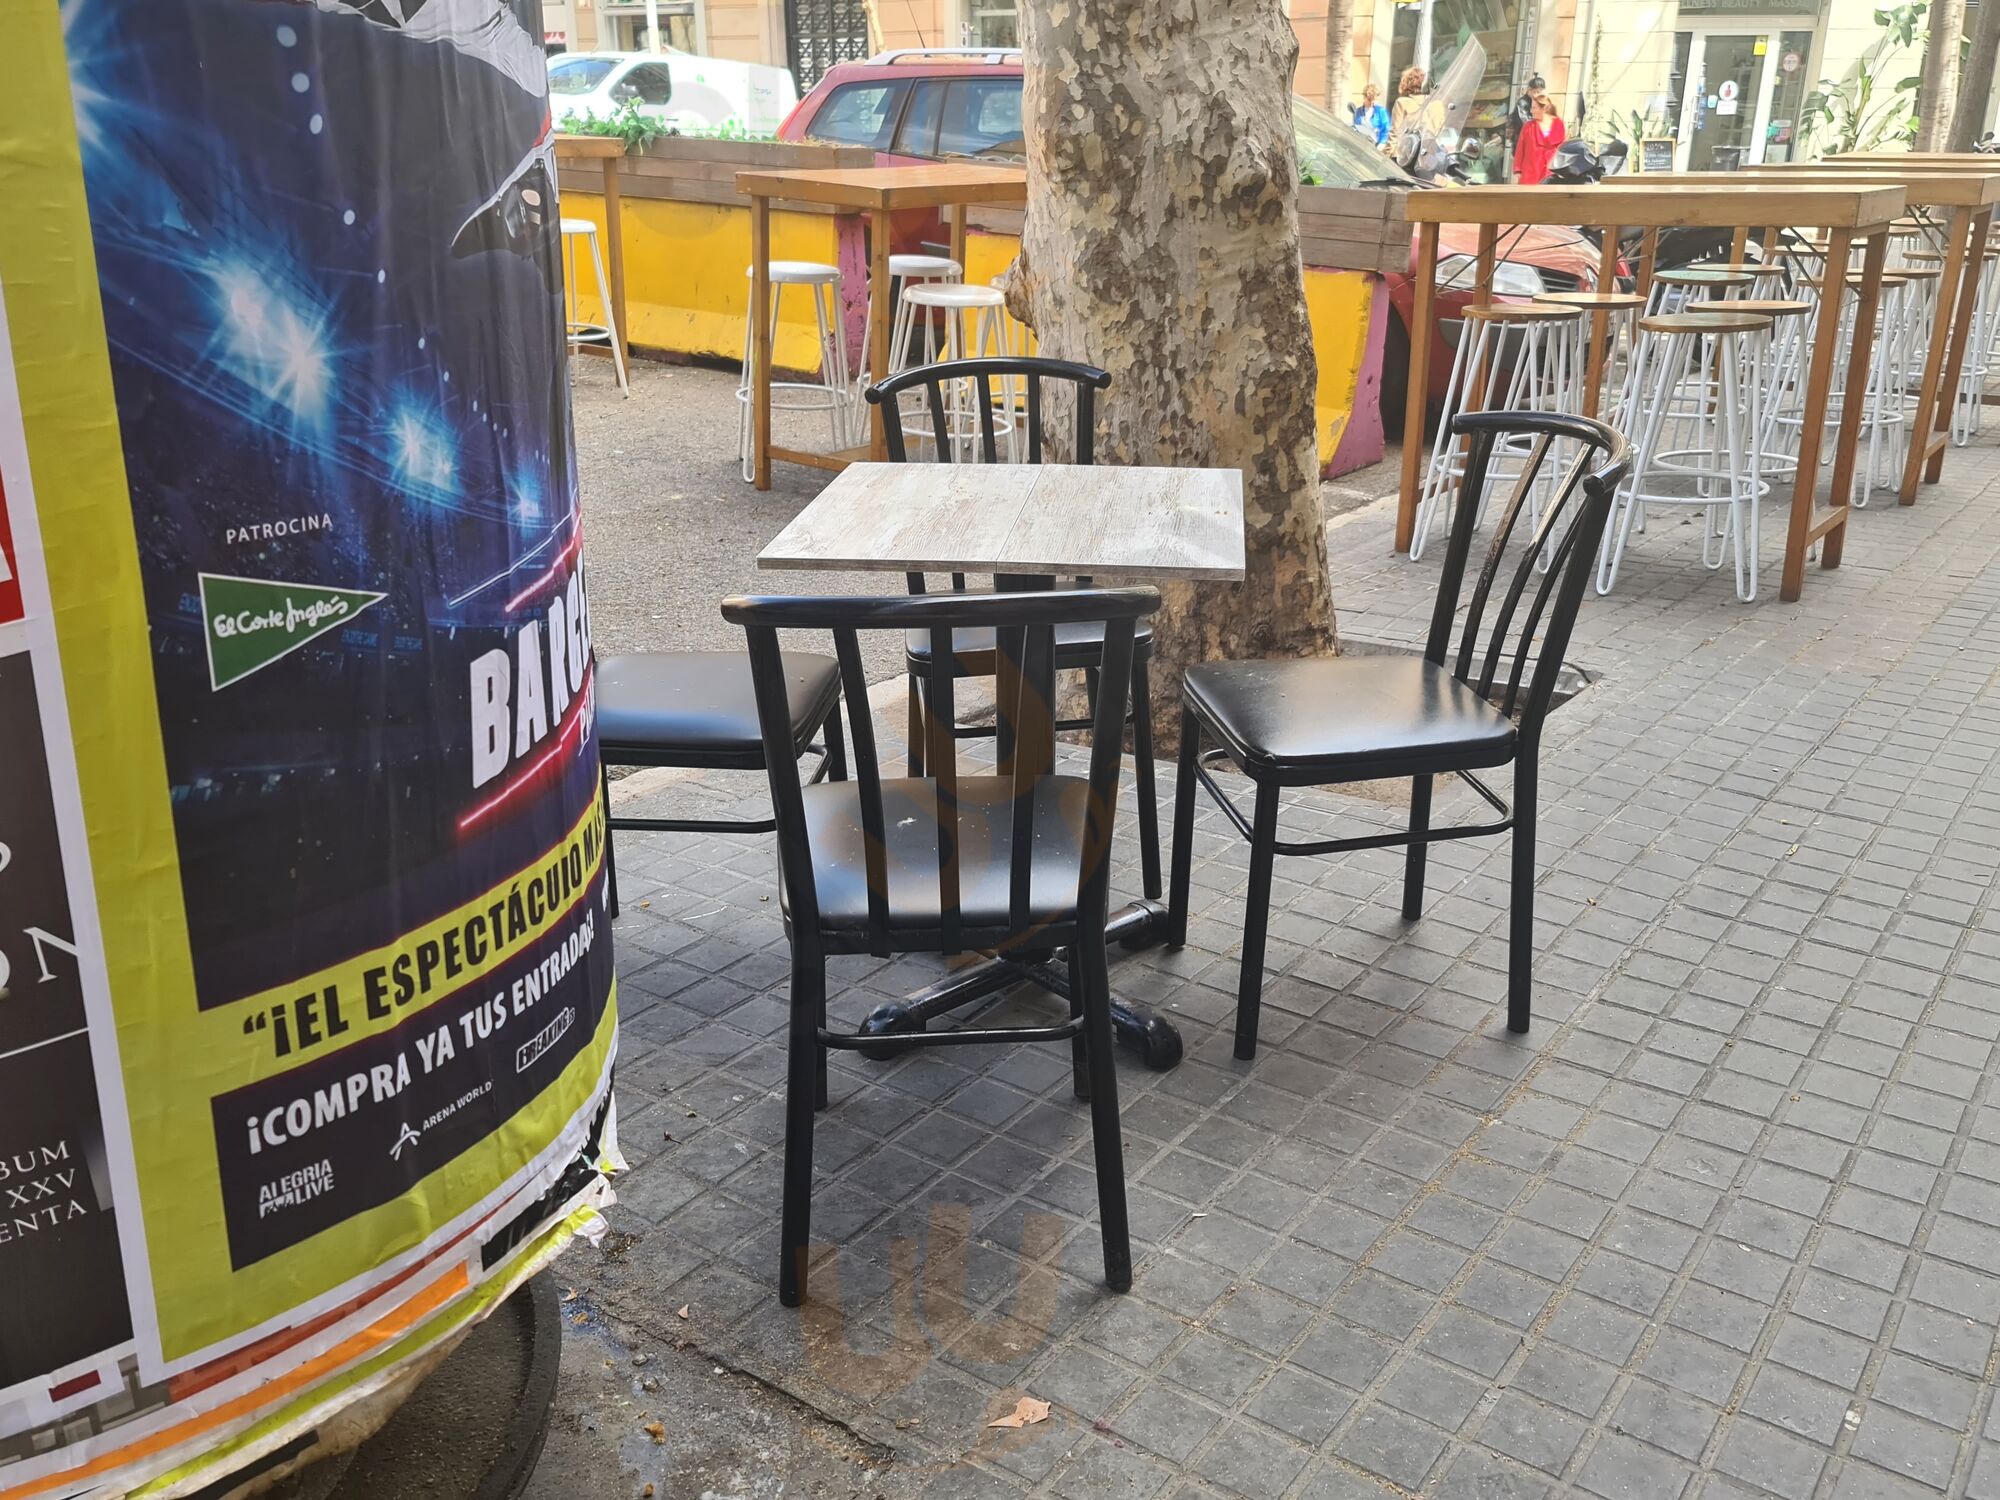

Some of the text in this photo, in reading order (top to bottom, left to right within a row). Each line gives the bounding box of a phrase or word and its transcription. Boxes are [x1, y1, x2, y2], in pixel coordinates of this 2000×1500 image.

[226, 513, 334, 545] PATROCINA
[214, 595, 349, 638] El Corte Inglés
[470, 548, 592, 789] BARCE
[247, 1052, 411, 1155] ¡COMPRA
[415, 1026, 456, 1074] YA
[458, 996, 508, 1049] TUS
[422, 1081, 493, 1131] ARENA WORLD
[5, 1168, 75, 1208] XXV
